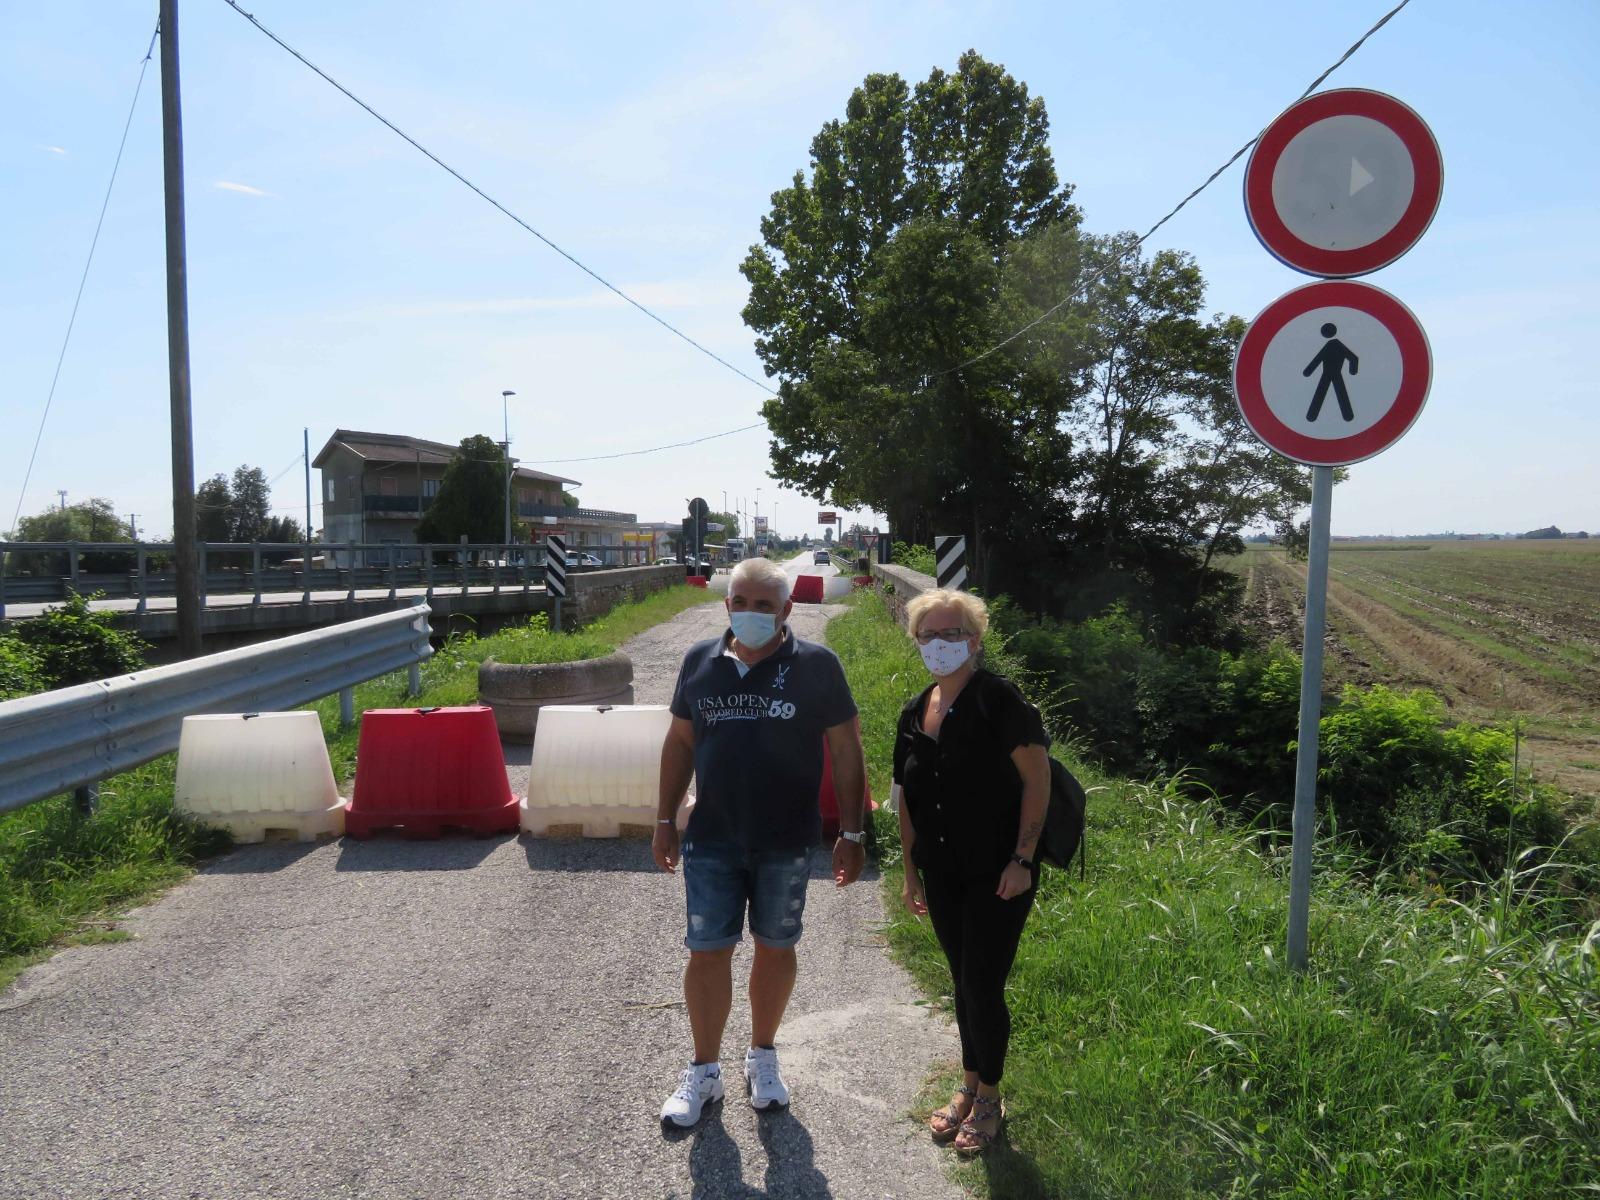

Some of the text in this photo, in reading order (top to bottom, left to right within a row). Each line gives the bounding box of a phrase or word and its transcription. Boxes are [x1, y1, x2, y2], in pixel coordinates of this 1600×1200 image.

[697, 694, 769, 710] USA OPEN
[768, 699, 796, 720] 59
[702, 708, 768, 719] TAILORED CLUB
